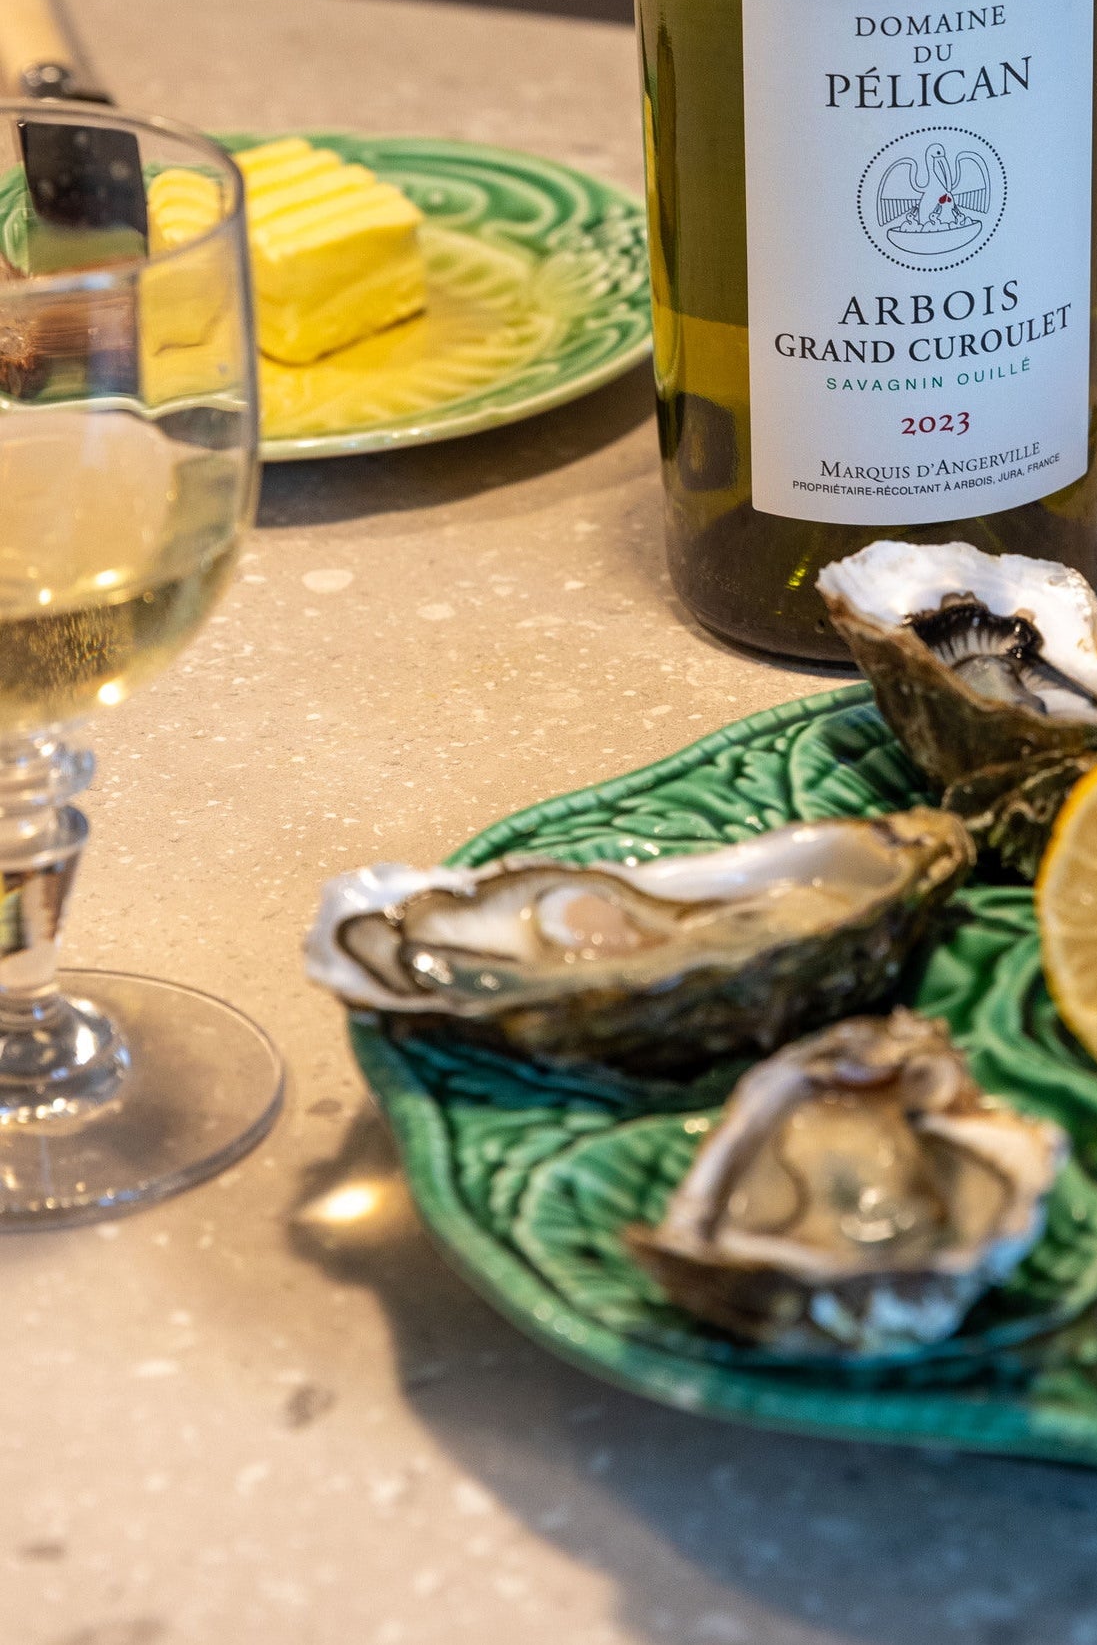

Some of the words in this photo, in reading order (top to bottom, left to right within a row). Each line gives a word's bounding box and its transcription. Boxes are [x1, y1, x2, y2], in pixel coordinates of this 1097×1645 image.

[854, 4, 1007, 37] DOMAINE
[913, 43, 953, 64] DU
[825, 56, 1032, 109] PÉLICAN
[838, 280, 1019, 325] ARBOIS
[774, 333, 895, 364] GRAND
[908, 303, 1072, 362] CUROULET
[826, 375, 943, 391] SAVAGNIN
[956, 357, 1031, 386] OUILLÉ
[901, 411, 970, 436] 2023
[792, 480, 941, 497] PROPRIÉTAIRE-RÉCOLTANT
[943, 480, 953, 491] À
[953, 476, 996, 491] ARBOIS,
[998, 469, 1025, 482] JURA,
[1027, 453, 1060, 472] FRANCE
[820, 460, 911, 483] MARQUIS
